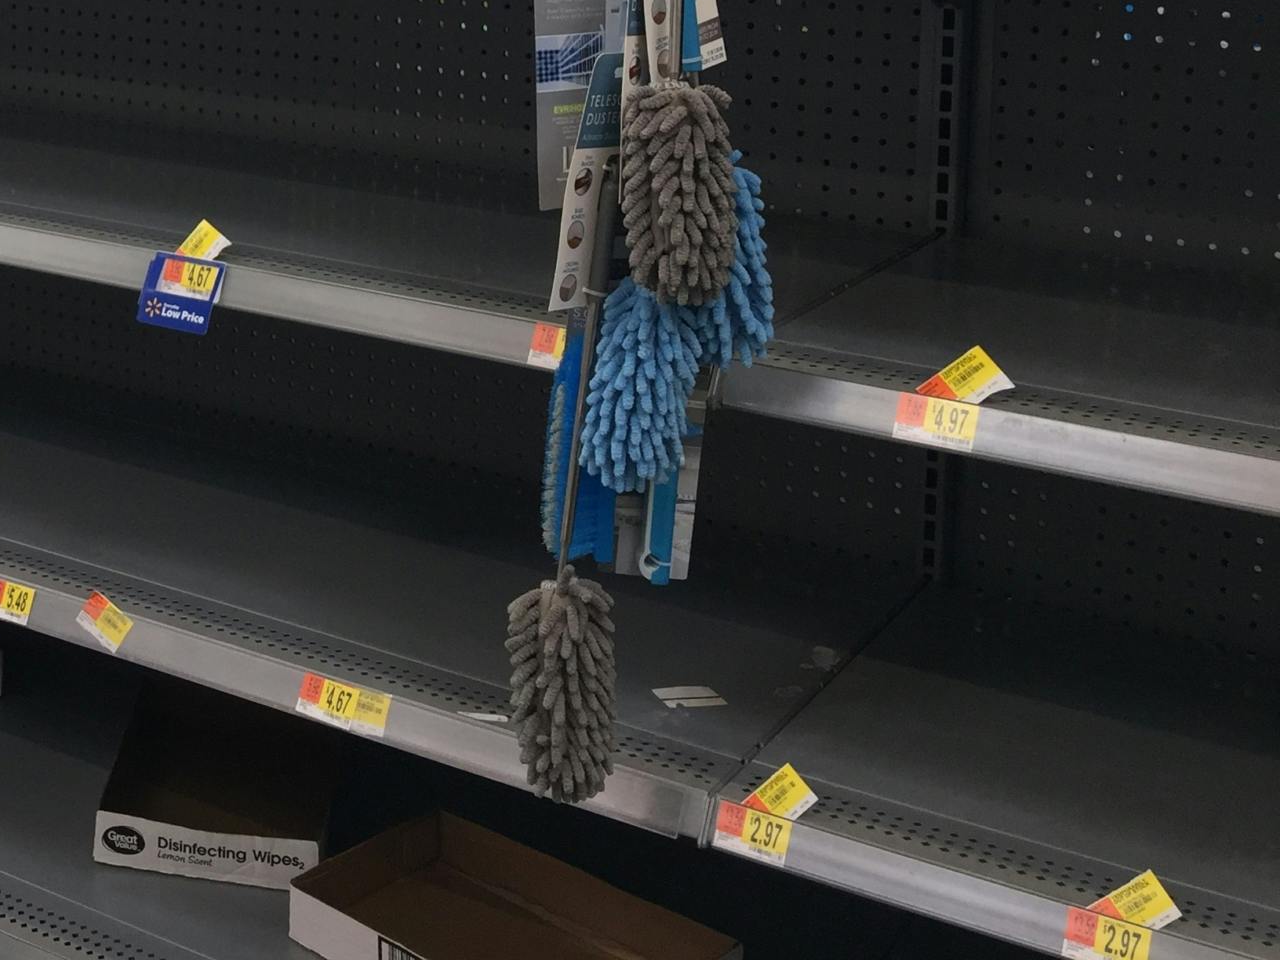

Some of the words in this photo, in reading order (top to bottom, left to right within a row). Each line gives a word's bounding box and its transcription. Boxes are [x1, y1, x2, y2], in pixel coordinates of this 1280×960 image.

[590, 93, 621, 108] TELES
[586, 111, 618, 126] DUSTE
[161, 307, 181, 320] Low
[181, 310, 205, 325] Price
[107, 829, 138, 845] Great
[114, 840, 139, 851] Value
[157, 836, 247, 864] Disinfecting
[157, 850, 187, 865] Lemon
